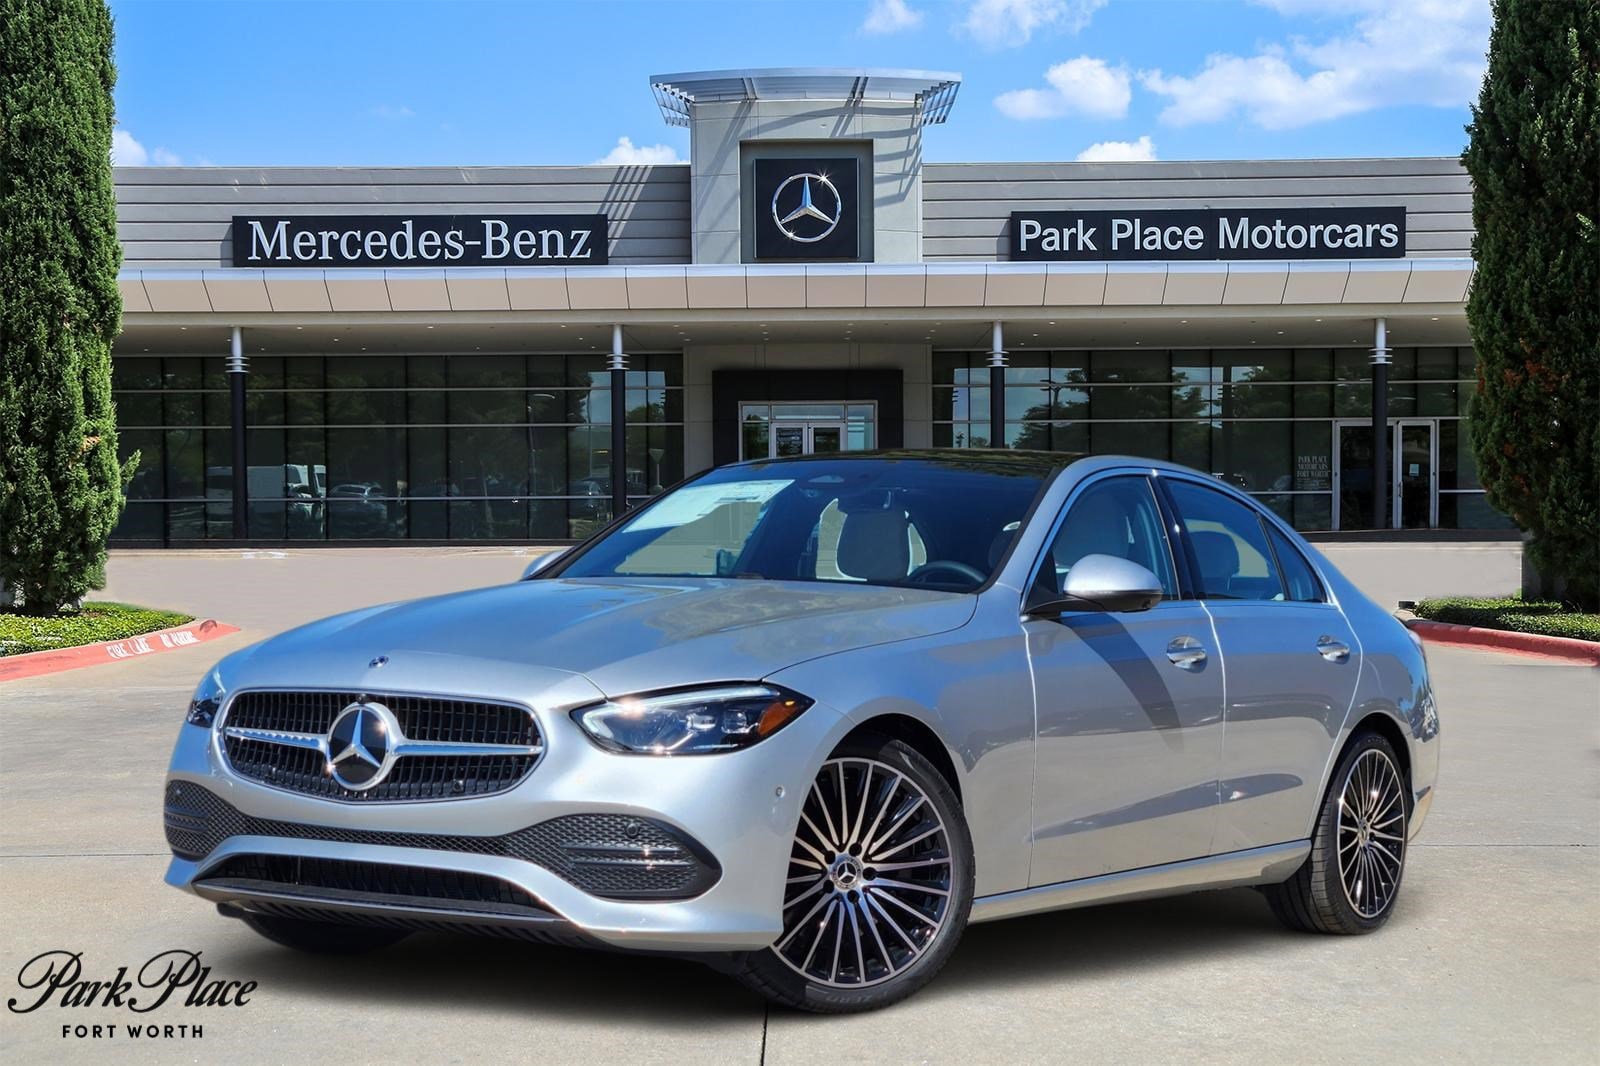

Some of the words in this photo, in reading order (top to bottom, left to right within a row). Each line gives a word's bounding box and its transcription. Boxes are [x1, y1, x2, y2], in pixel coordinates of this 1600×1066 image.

[247, 219, 592, 261] Mercedes-Benz
[1019, 218, 1098, 252] Park
[1111, 218, 1204, 251] Place
[1218, 217, 1399, 250] Motorcars
